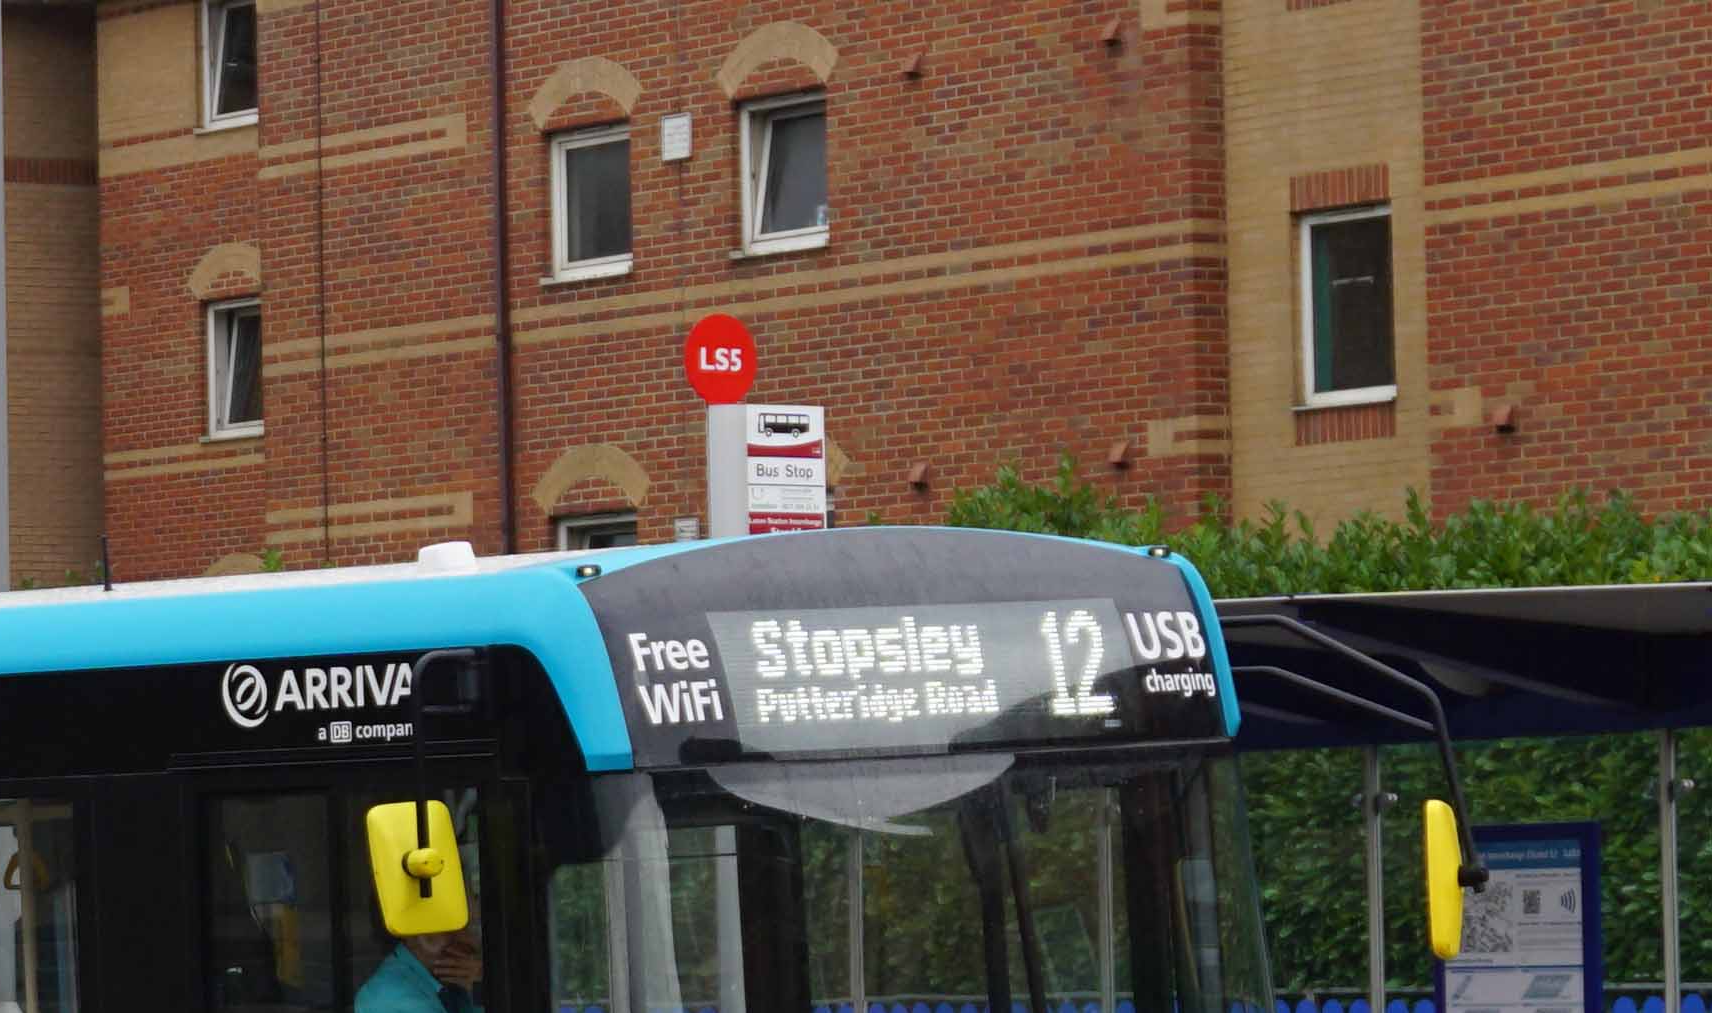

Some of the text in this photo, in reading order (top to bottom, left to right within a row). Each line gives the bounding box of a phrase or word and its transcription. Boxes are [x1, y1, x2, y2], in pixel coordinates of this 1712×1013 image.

[699, 346, 742, 372] LS5
[756, 463, 814, 479] Bus Stop
[627, 632, 710, 671] Free
[1125, 611, 1207, 660] USB
[750, 609, 1116, 716] Stopsley 12
[1144, 667, 1217, 697] charging
[274, 662, 413, 711] ARRIVA
[638, 679, 725, 724] WiFi
[757, 679, 1001, 722] Putteridge Road
[317, 721, 414, 742] a DB compan
